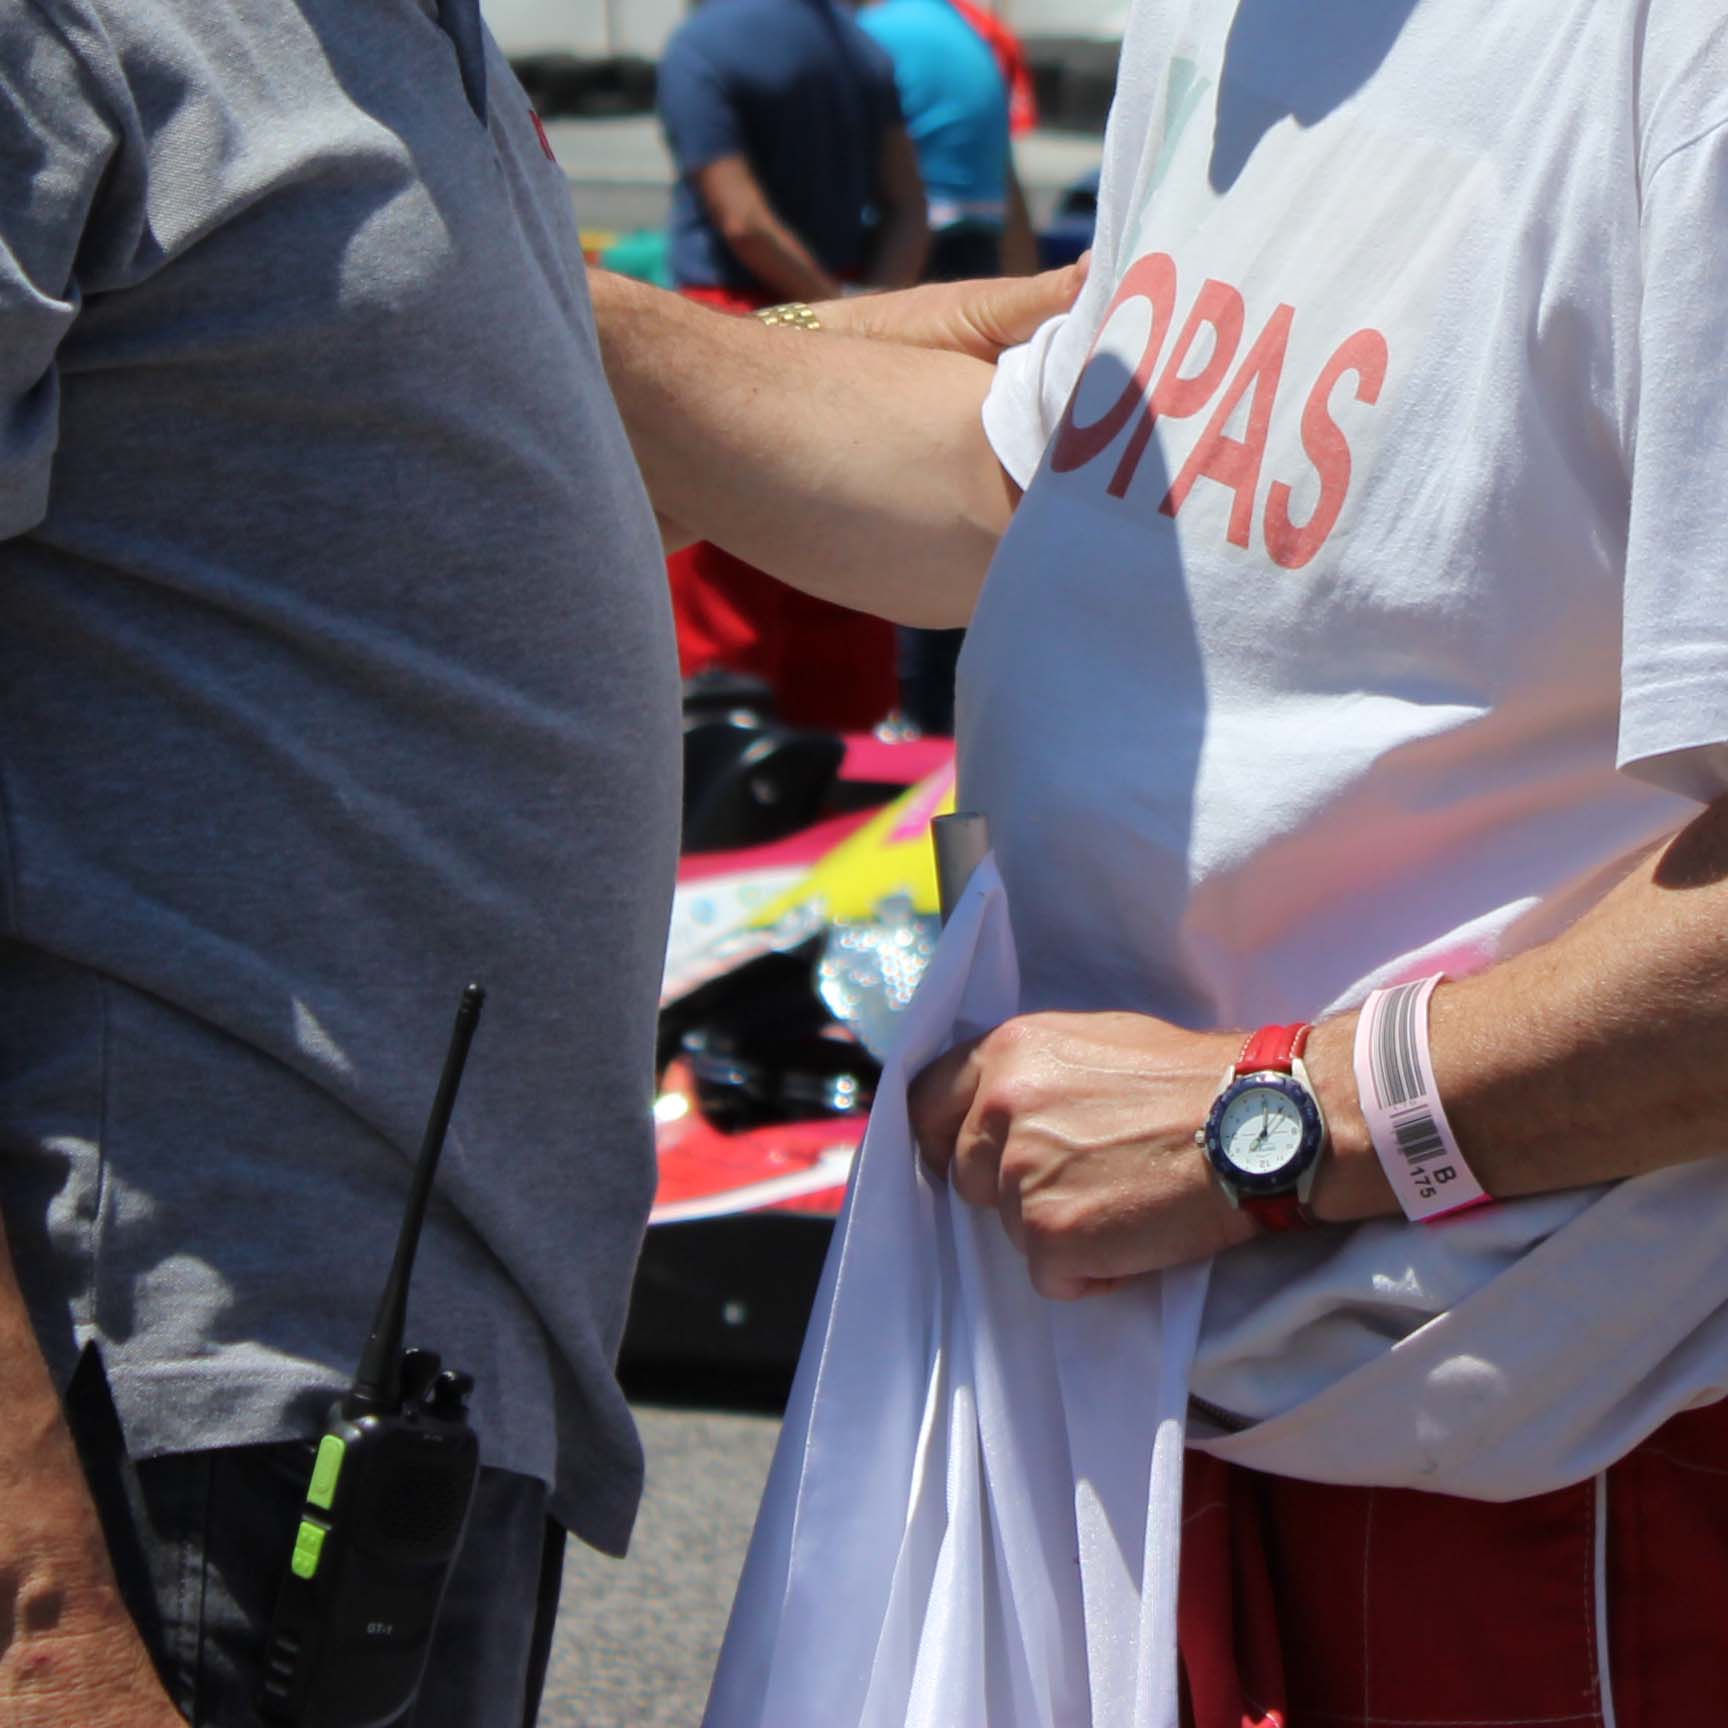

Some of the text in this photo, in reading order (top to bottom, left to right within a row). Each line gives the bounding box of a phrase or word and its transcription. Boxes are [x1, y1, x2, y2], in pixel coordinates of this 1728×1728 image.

[1050, 251, 1389, 571] OPAS
[1409, 1166, 1437, 1199] 175
[1432, 1165, 1457, 1184] B
